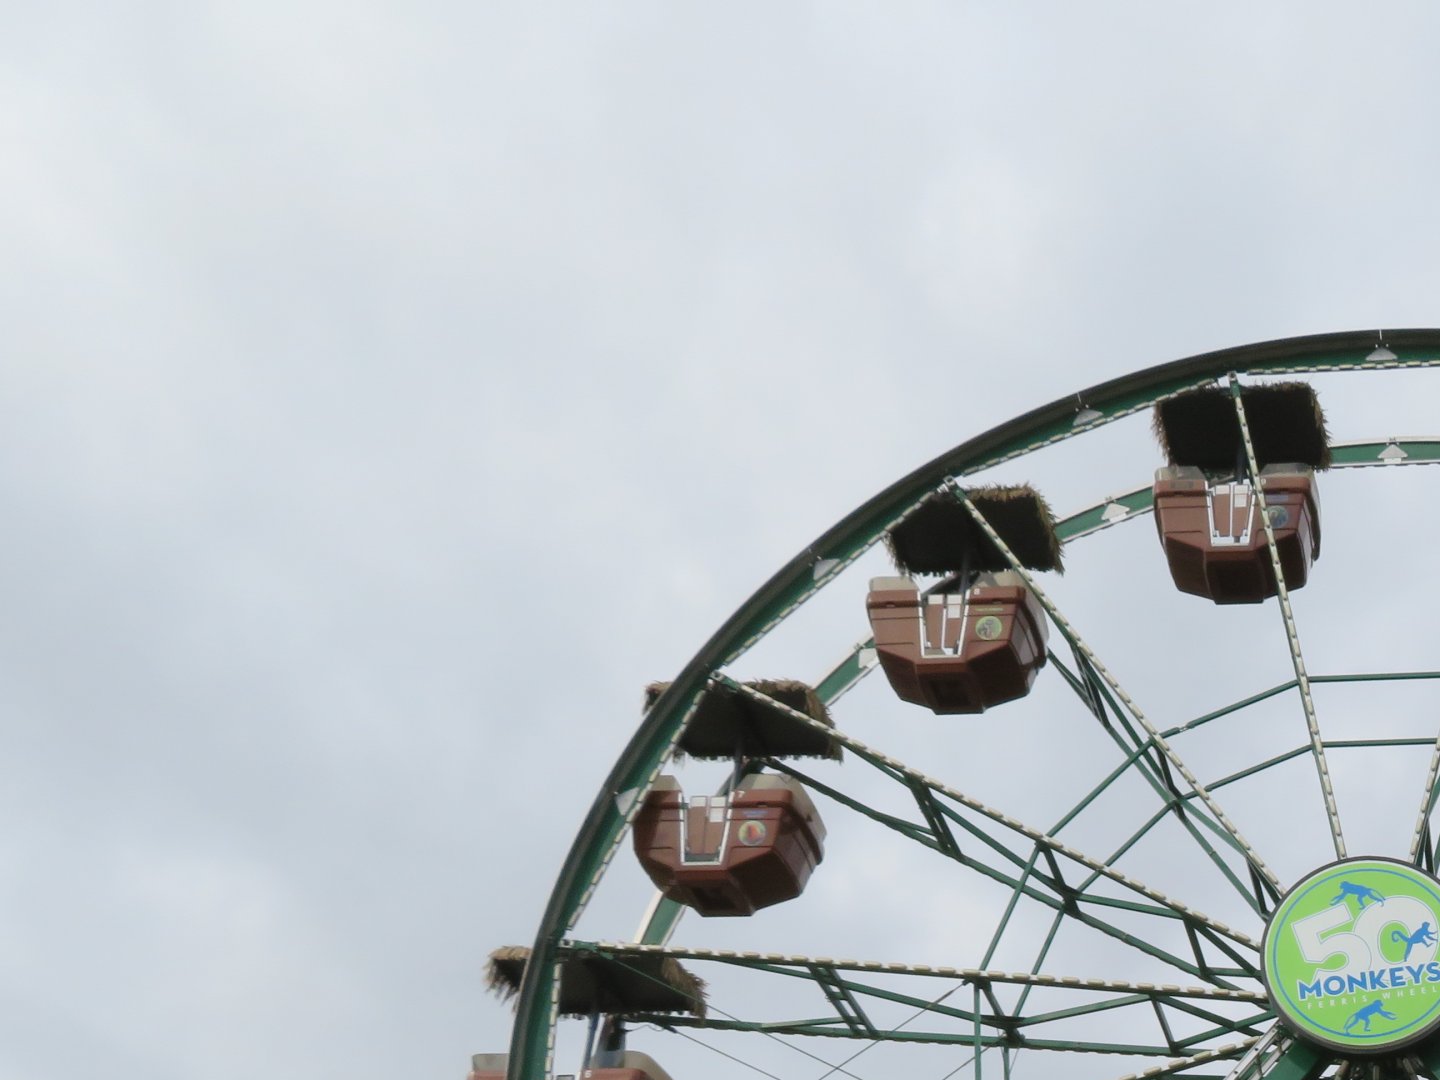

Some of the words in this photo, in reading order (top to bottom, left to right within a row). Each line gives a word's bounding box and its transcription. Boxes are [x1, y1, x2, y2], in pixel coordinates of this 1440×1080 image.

[1291, 895, 1440, 982] 50
[1306, 995, 1368, 1010] FERRIS
[1382, 986, 1438, 1000] WHEEL
